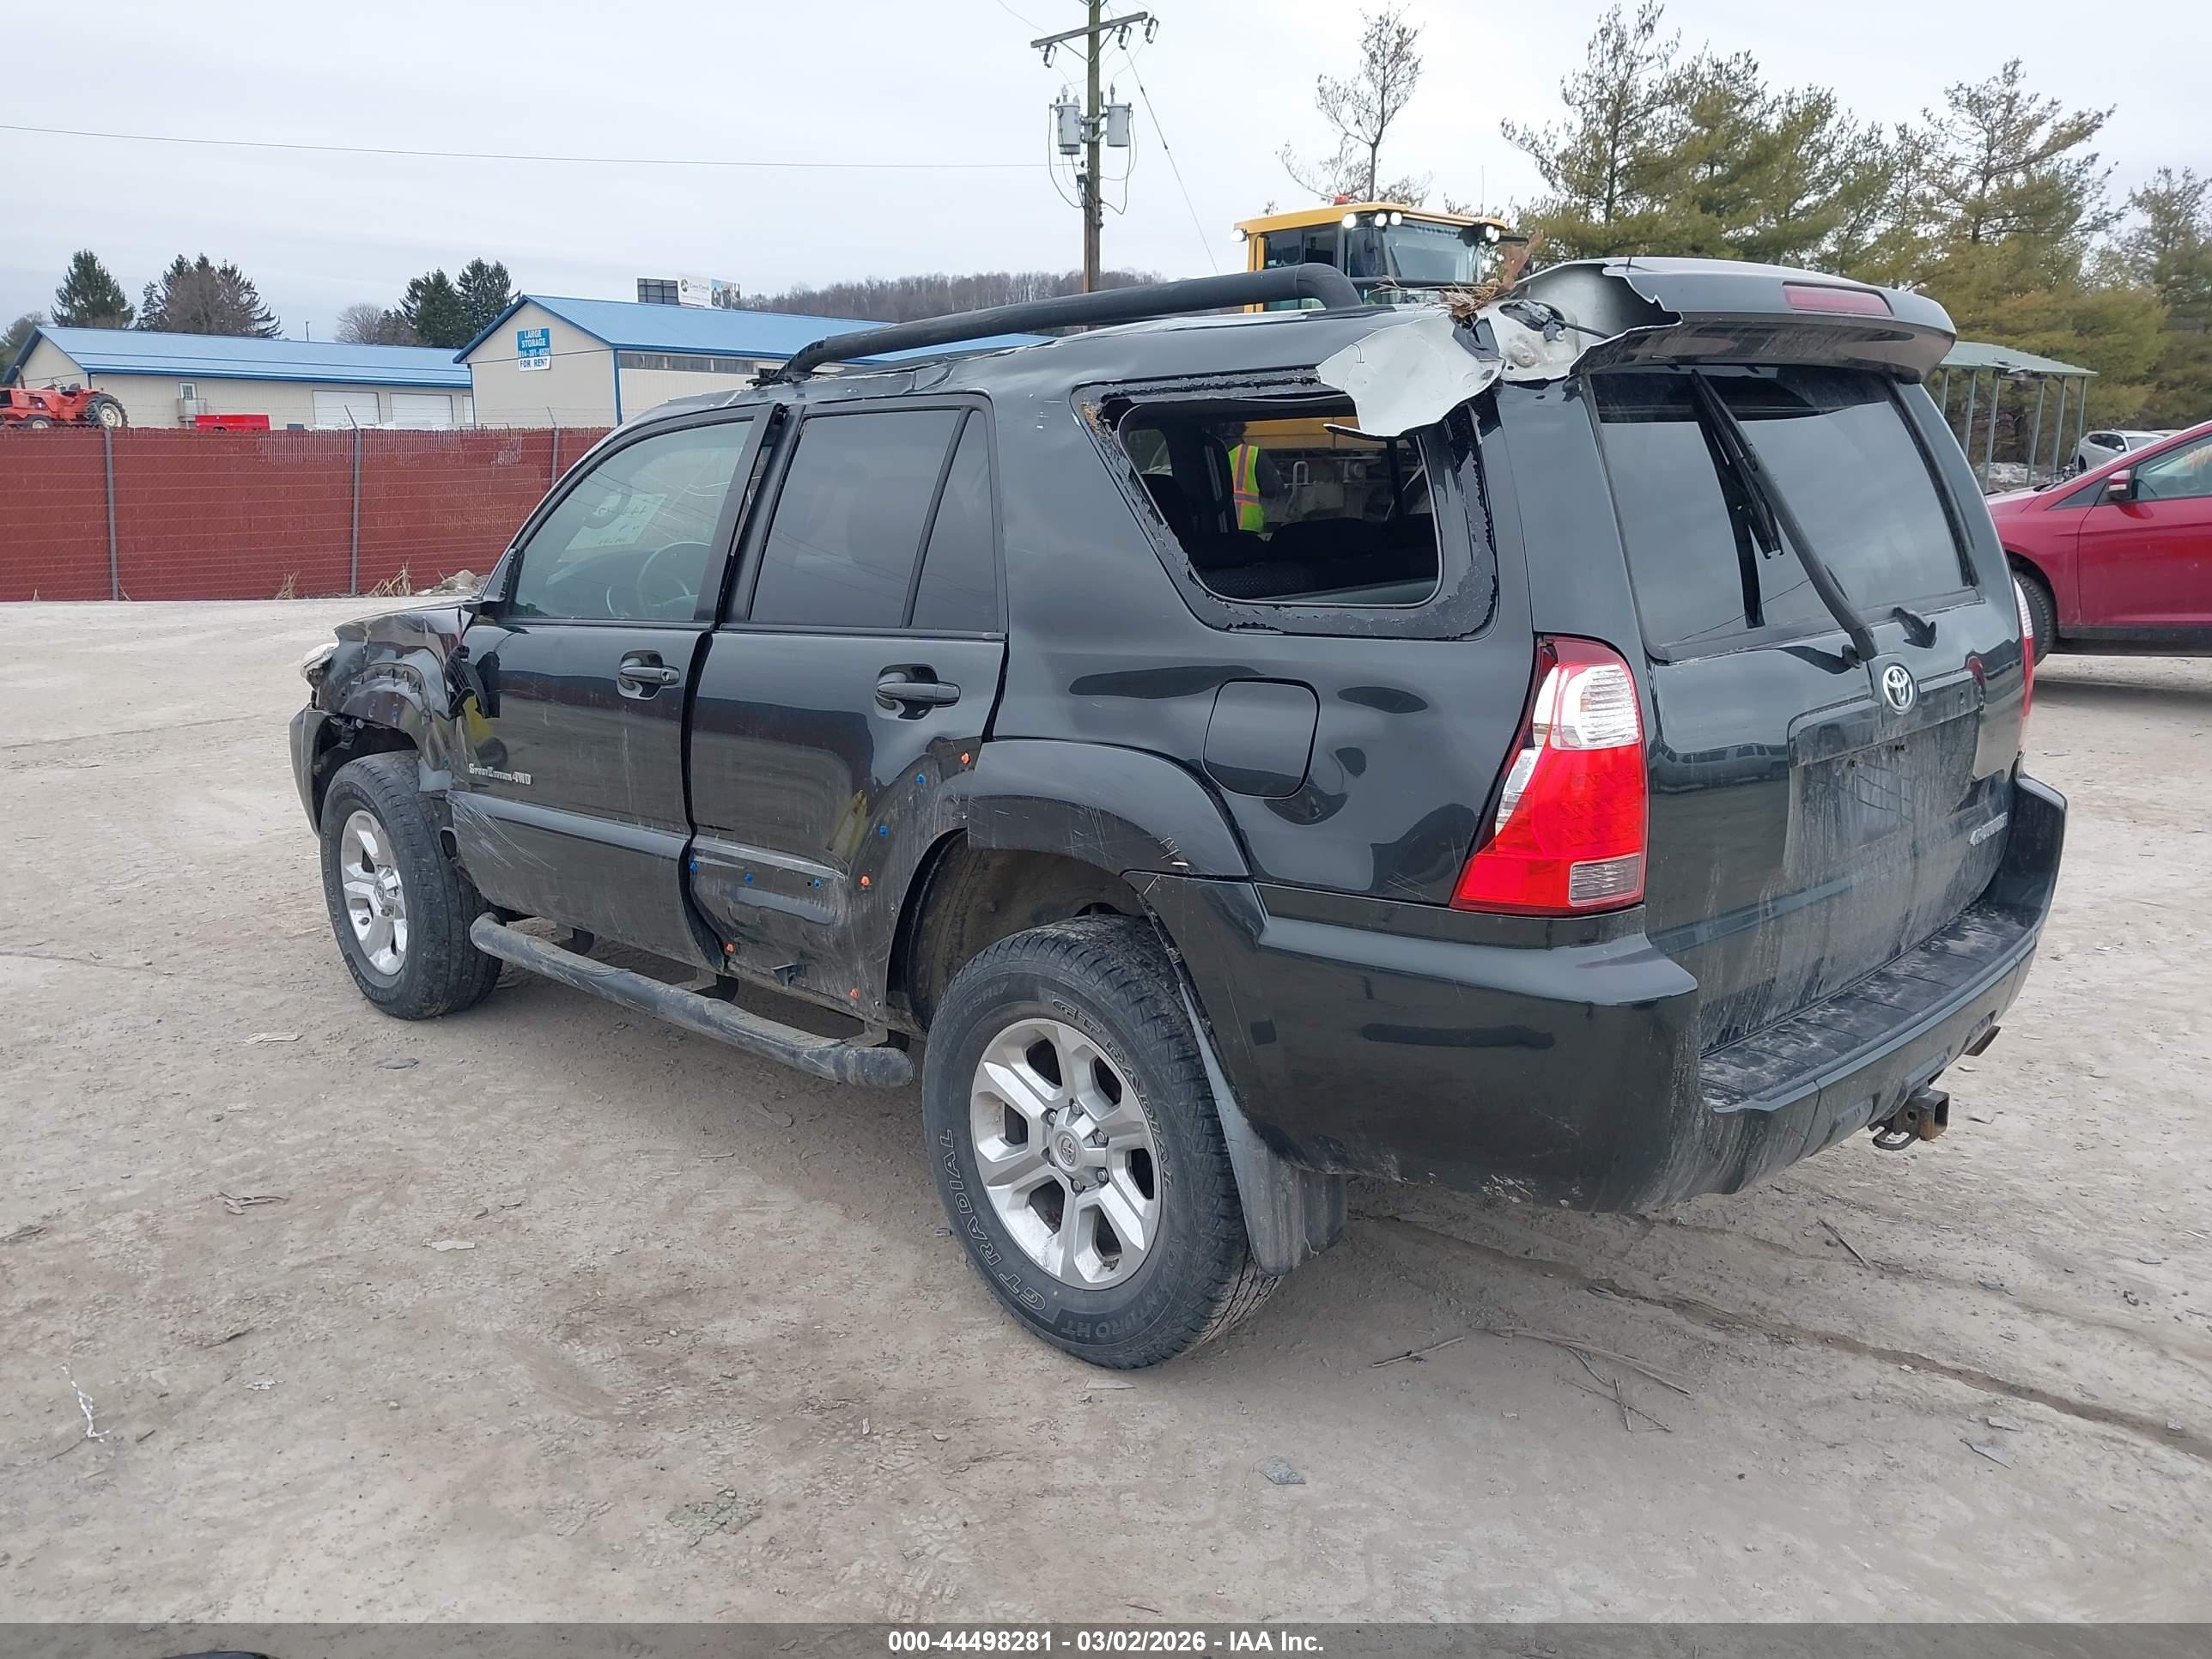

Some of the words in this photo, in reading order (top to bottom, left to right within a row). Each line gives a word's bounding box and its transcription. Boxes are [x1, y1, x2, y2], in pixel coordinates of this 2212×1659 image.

[525, 329, 542, 339] LARGE
[521, 337, 546, 349] STORAGE
[520, 359, 532, 368] FOR
[533, 358, 548, 368] RENT
[513, 770, 532, 785] 4WD
[1052, 999, 1102, 1034] GT
[1105, 1038, 1174, 1190] RADIAL
[939, 1128, 1003, 1266] RADIAL
[998, 1273, 1046, 1310] GT
